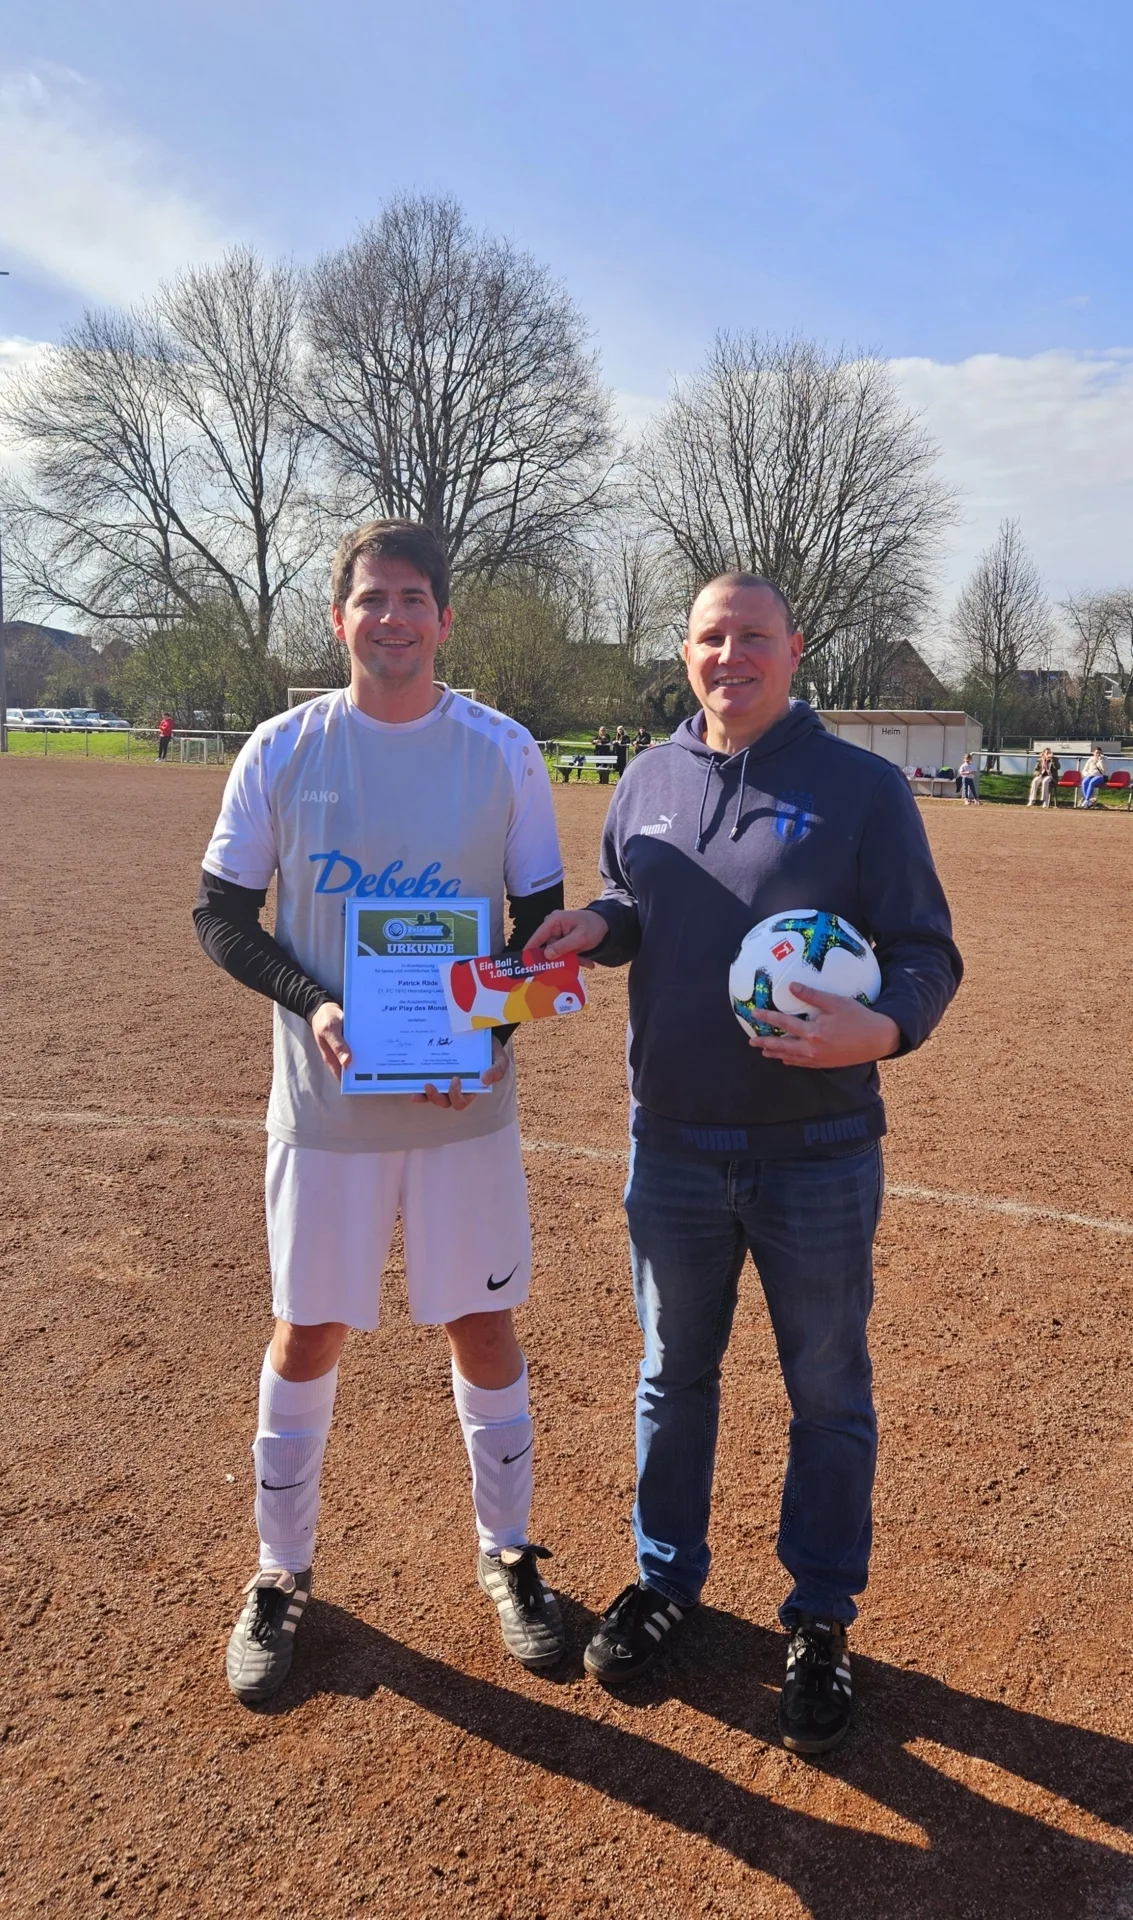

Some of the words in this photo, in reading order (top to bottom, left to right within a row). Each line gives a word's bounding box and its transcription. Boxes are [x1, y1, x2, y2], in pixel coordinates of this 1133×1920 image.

[882, 727, 901, 736] Heim
[301, 789, 339, 804] JAKO
[640, 823, 668, 836] PUMA
[308, 849, 461, 898] Debeka
[387, 943, 454, 954] URKUNDE
[479, 962, 494, 971] Ein
[495, 958, 512, 968] Ball
[490, 968, 513, 979] 1.000
[515, 961, 564, 975] Geschichten
[803, 1115, 868, 1146] PUMA
[679, 1128, 747, 1150] PUMA
